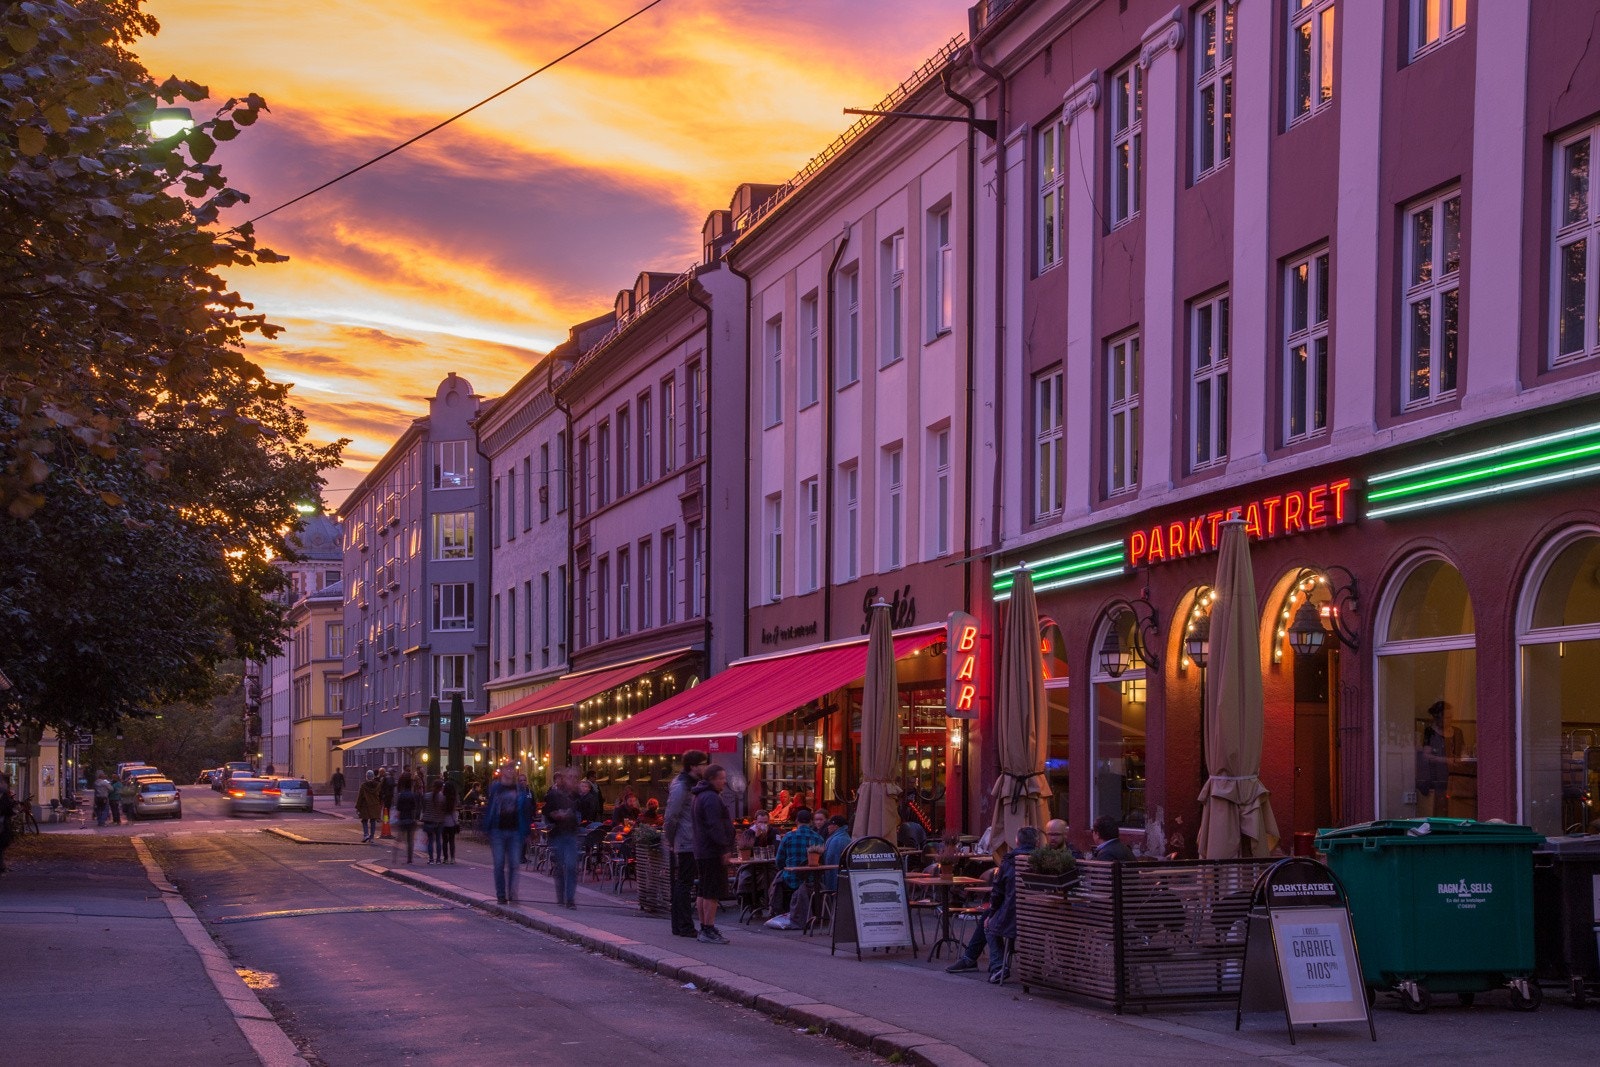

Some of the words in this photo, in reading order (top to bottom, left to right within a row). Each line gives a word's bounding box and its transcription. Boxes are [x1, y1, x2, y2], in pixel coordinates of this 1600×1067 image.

[956, 626, 977, 710] BAR
[1470, 883, 1492, 893] SELLS
[1292, 940, 1336, 957] GABRIEL
[1306, 962, 1331, 980] RIOS
